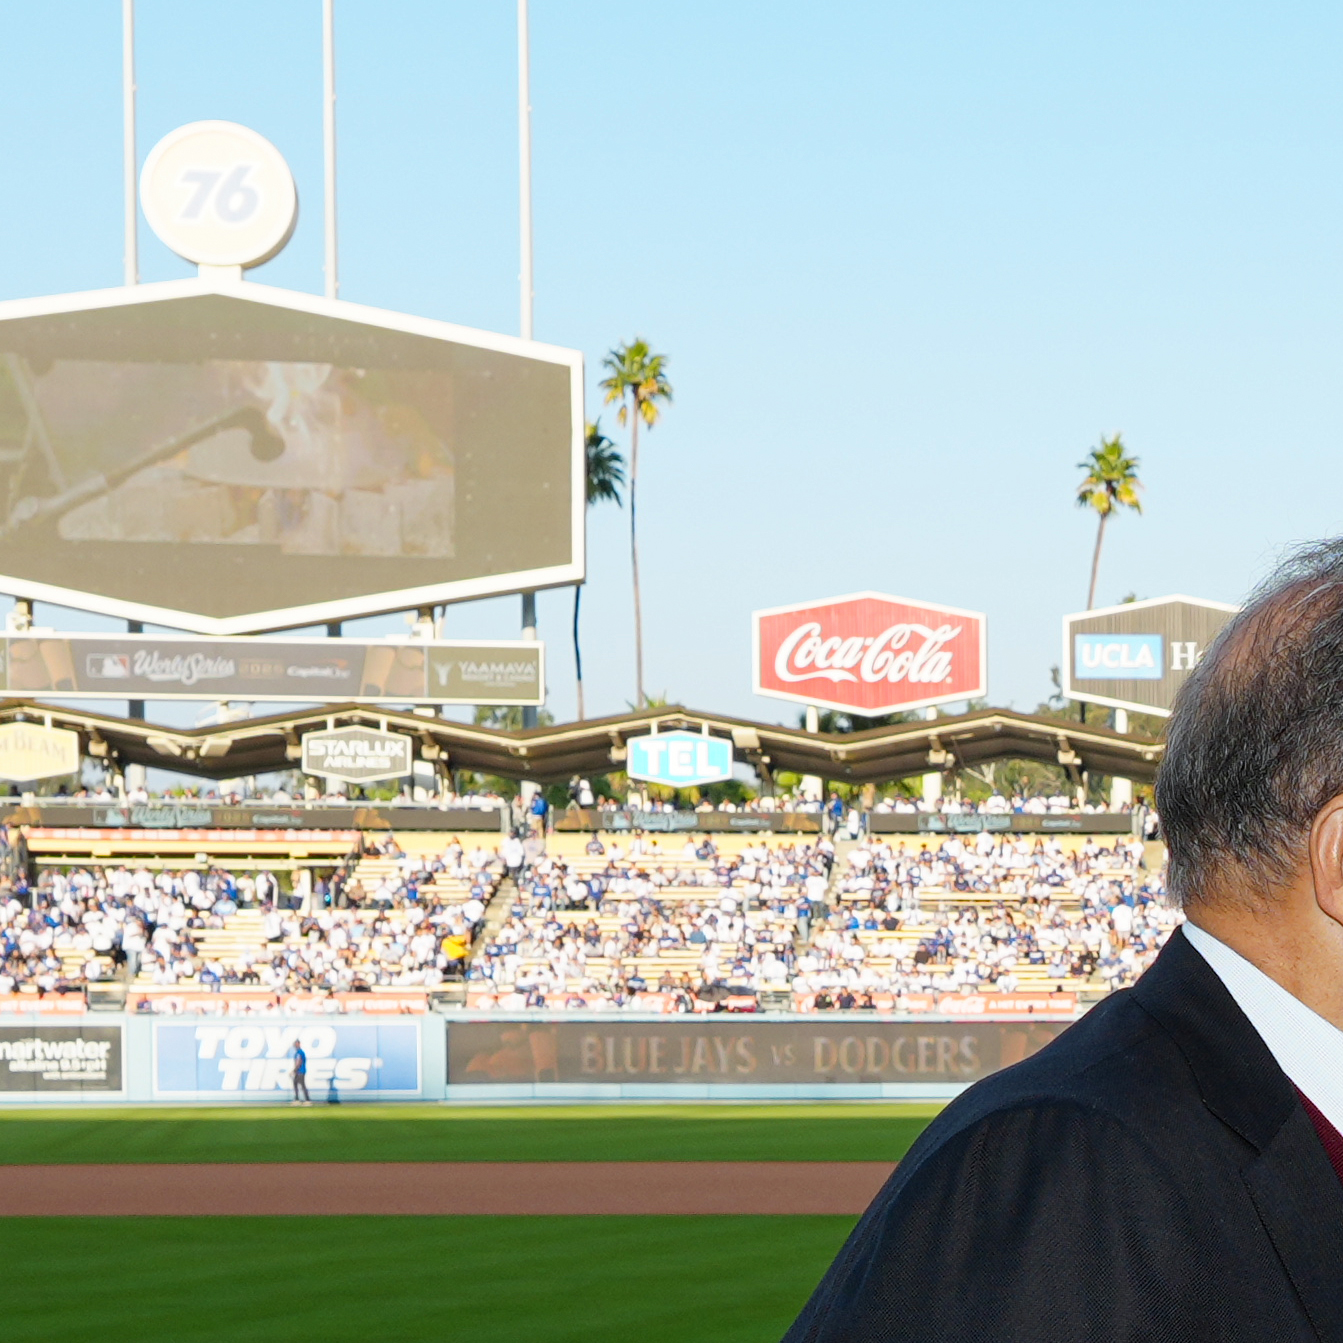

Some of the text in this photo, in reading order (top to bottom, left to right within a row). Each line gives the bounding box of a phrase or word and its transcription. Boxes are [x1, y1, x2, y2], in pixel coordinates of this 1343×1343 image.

[178, 162, 260, 225] 76
[773, 620, 962, 685] Coca-Cola
[1081, 642, 1155, 669] UCLA
[308, 739, 405, 757] STARLUX
[323, 756, 391, 769] AIRLINES
[638, 740, 722, 777] TEL
[0, 1037, 111, 1061] martwater
[194, 1024, 337, 1060] TOYO
[580, 1035, 668, 1076] BLUE
[673, 1035, 757, 1077] JAYS
[813, 1035, 980, 1075] DODGERS
[218, 1057, 372, 1091] TIRES
